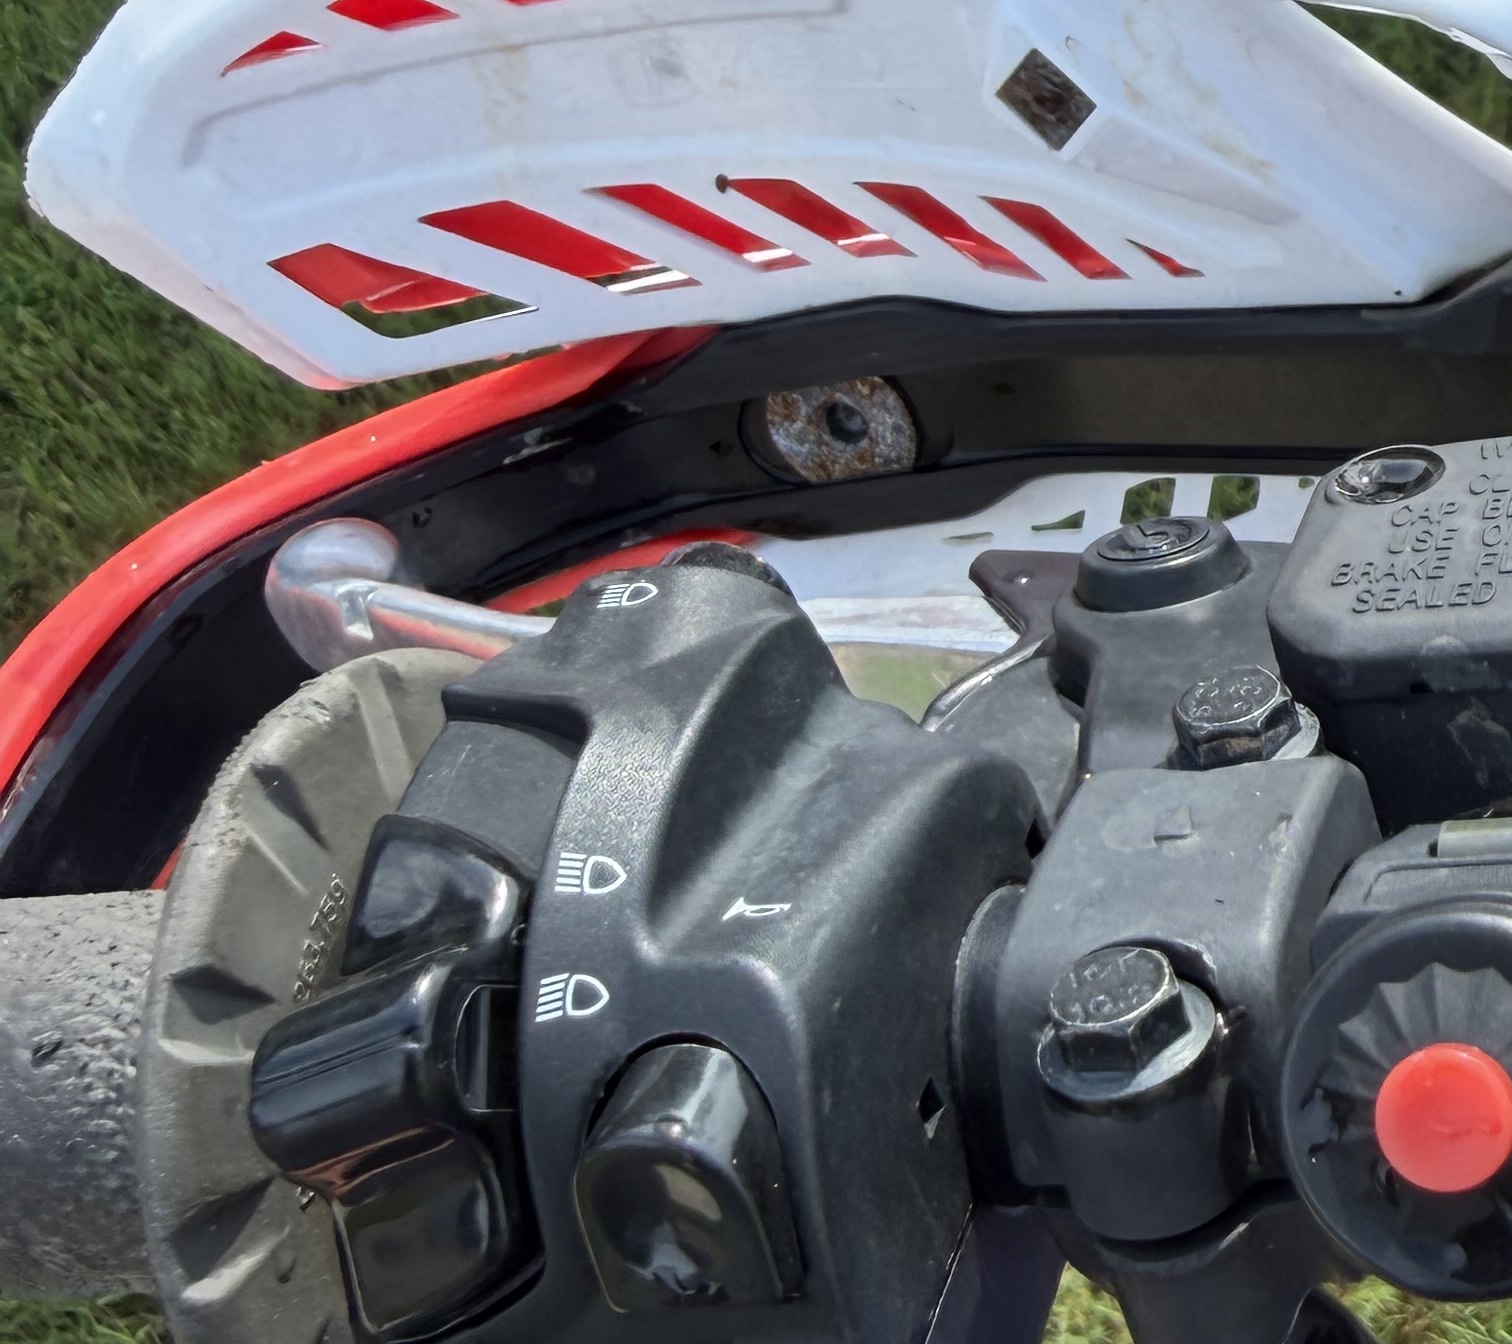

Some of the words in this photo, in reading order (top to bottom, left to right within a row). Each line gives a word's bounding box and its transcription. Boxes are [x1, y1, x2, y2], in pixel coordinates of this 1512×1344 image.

[1391, 501, 1460, 528] CAP
[1387, 528, 1459, 555] USE
[1331, 556, 1450, 587] BRAKE
[1351, 581, 1497, 614] SEALED
